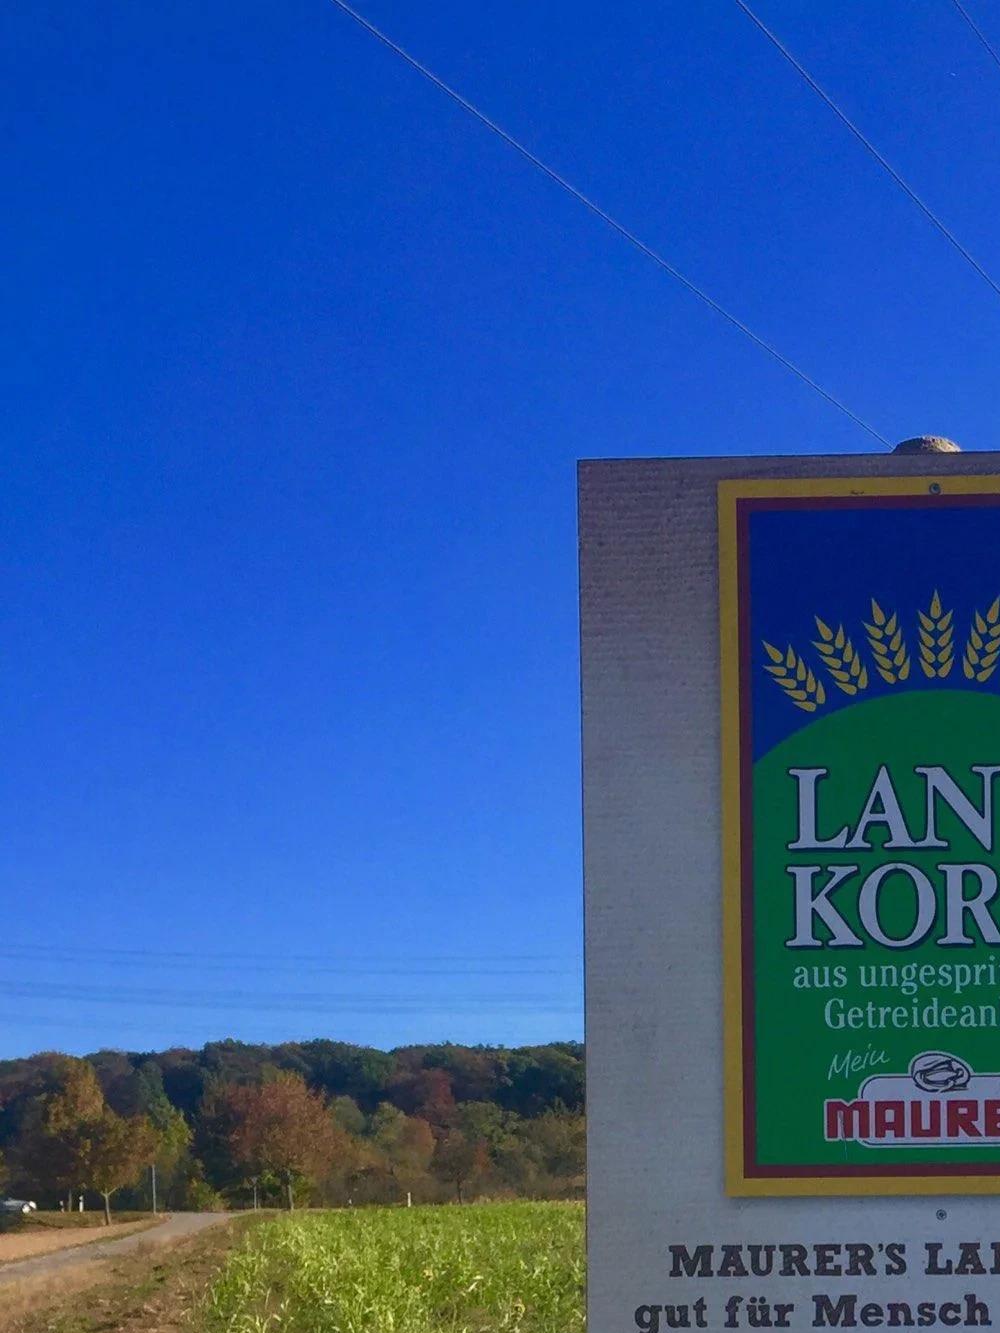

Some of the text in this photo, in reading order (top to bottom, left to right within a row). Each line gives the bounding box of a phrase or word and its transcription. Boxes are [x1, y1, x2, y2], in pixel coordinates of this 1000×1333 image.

[794, 966, 847, 988] aus
[828, 1044, 890, 1080] Mein
[724, 1296, 794, 1328] für
[812, 1294, 992, 1327] Mensch
